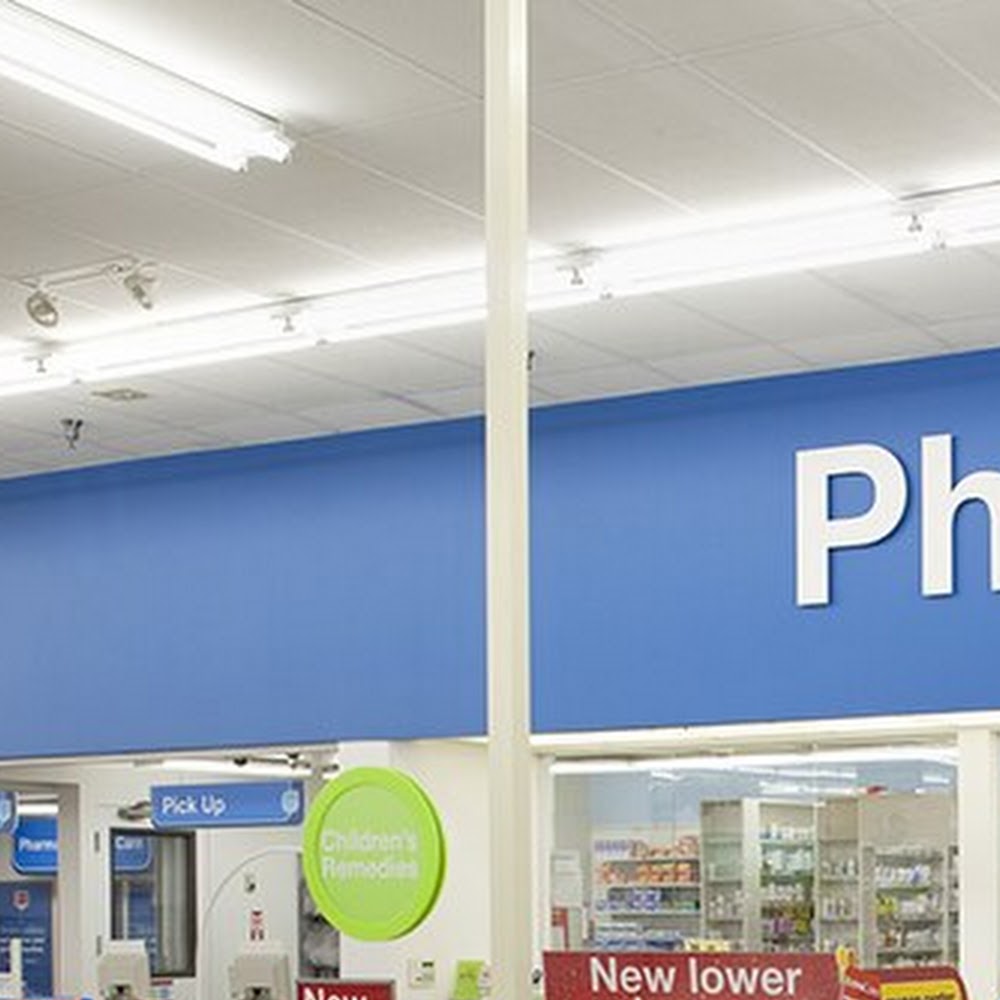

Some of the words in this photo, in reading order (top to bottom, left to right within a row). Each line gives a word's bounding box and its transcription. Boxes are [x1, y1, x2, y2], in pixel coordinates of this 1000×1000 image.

[161, 796, 198, 815] Pick
[201, 794, 227, 816] Up
[321, 829, 418, 853] Children's
[321, 857, 418, 880] Remedies
[590, 957, 676, 994] New
[688, 957, 802, 995] lower
